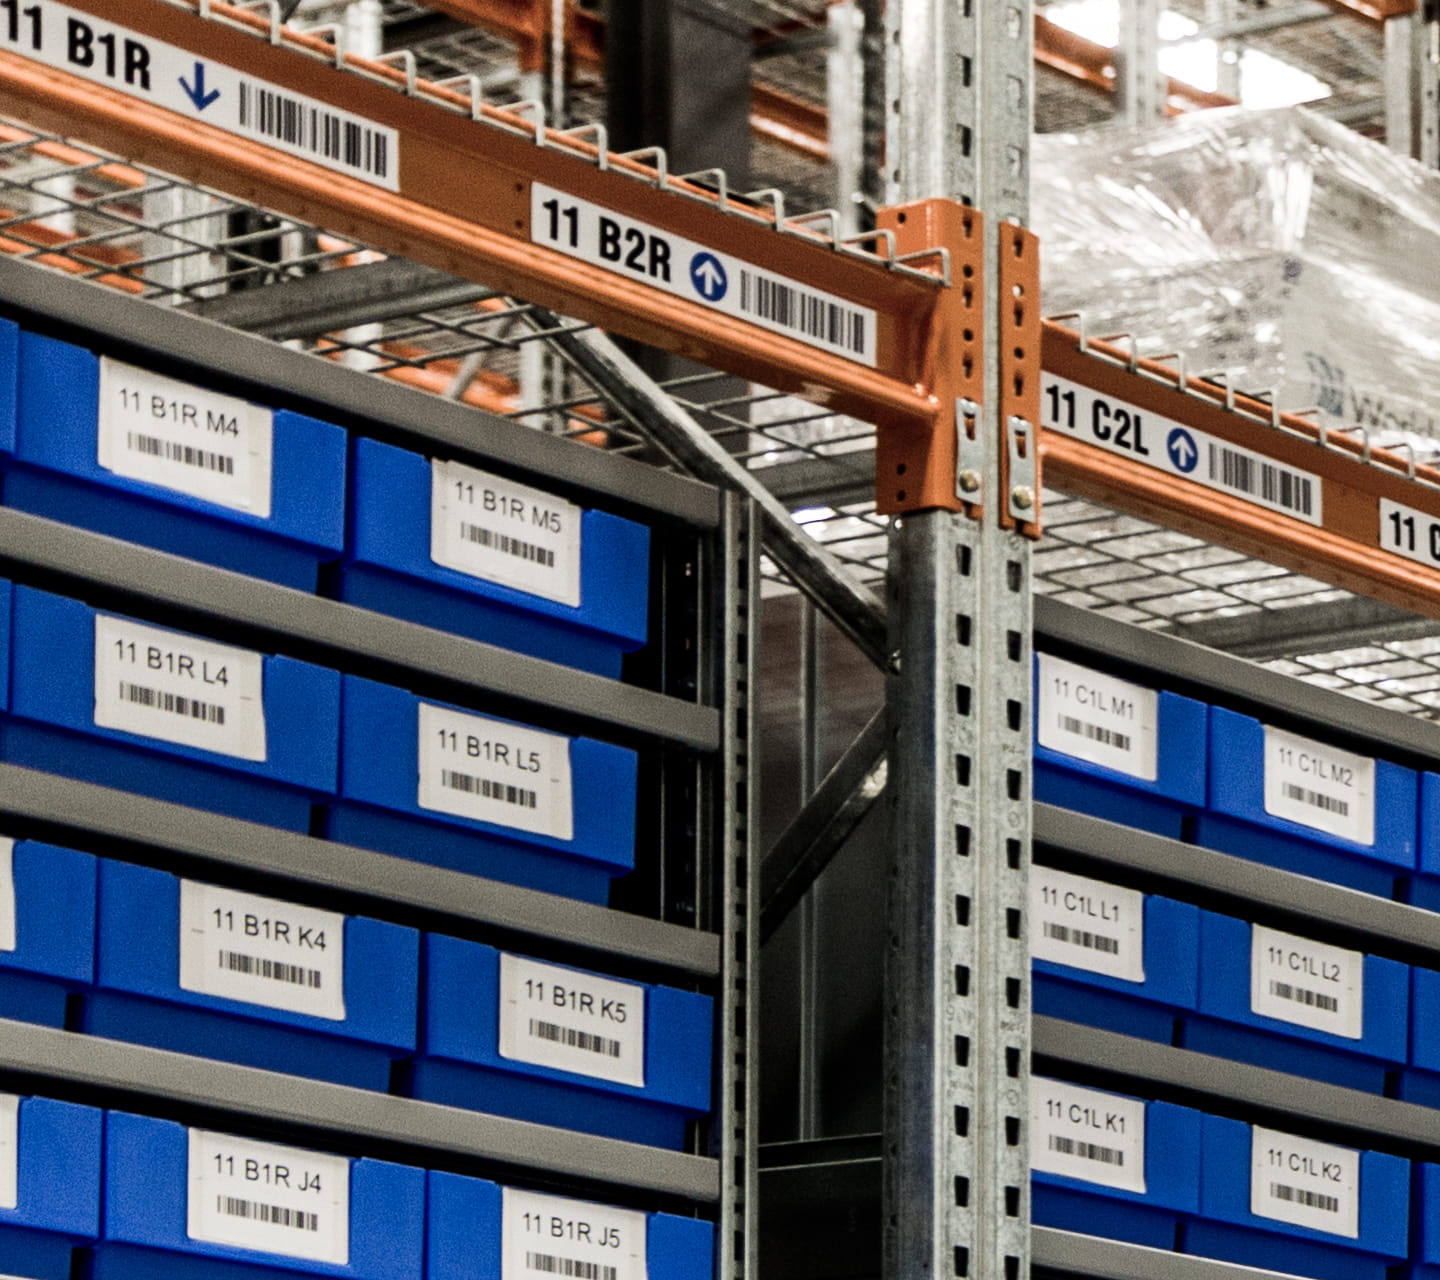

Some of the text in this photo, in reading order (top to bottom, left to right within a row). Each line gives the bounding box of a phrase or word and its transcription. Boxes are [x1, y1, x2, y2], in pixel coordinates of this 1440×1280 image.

[1, 0, 151, 91] 11 B1R
[542, 199, 671, 283] 11 B2R
[120, 388, 241, 440] 11 B1R M4
[1046, 384, 1149, 456] 11 C2L
[1389, 511, 1415, 551] 11
[439, 729, 540, 774] 11 B1R L5
[214, 908, 326, 950] 11 B1R K4
[1047, 1099, 1125, 1134] 11 C1L K1
[523, 1212, 620, 1250] 11 B1R J5
